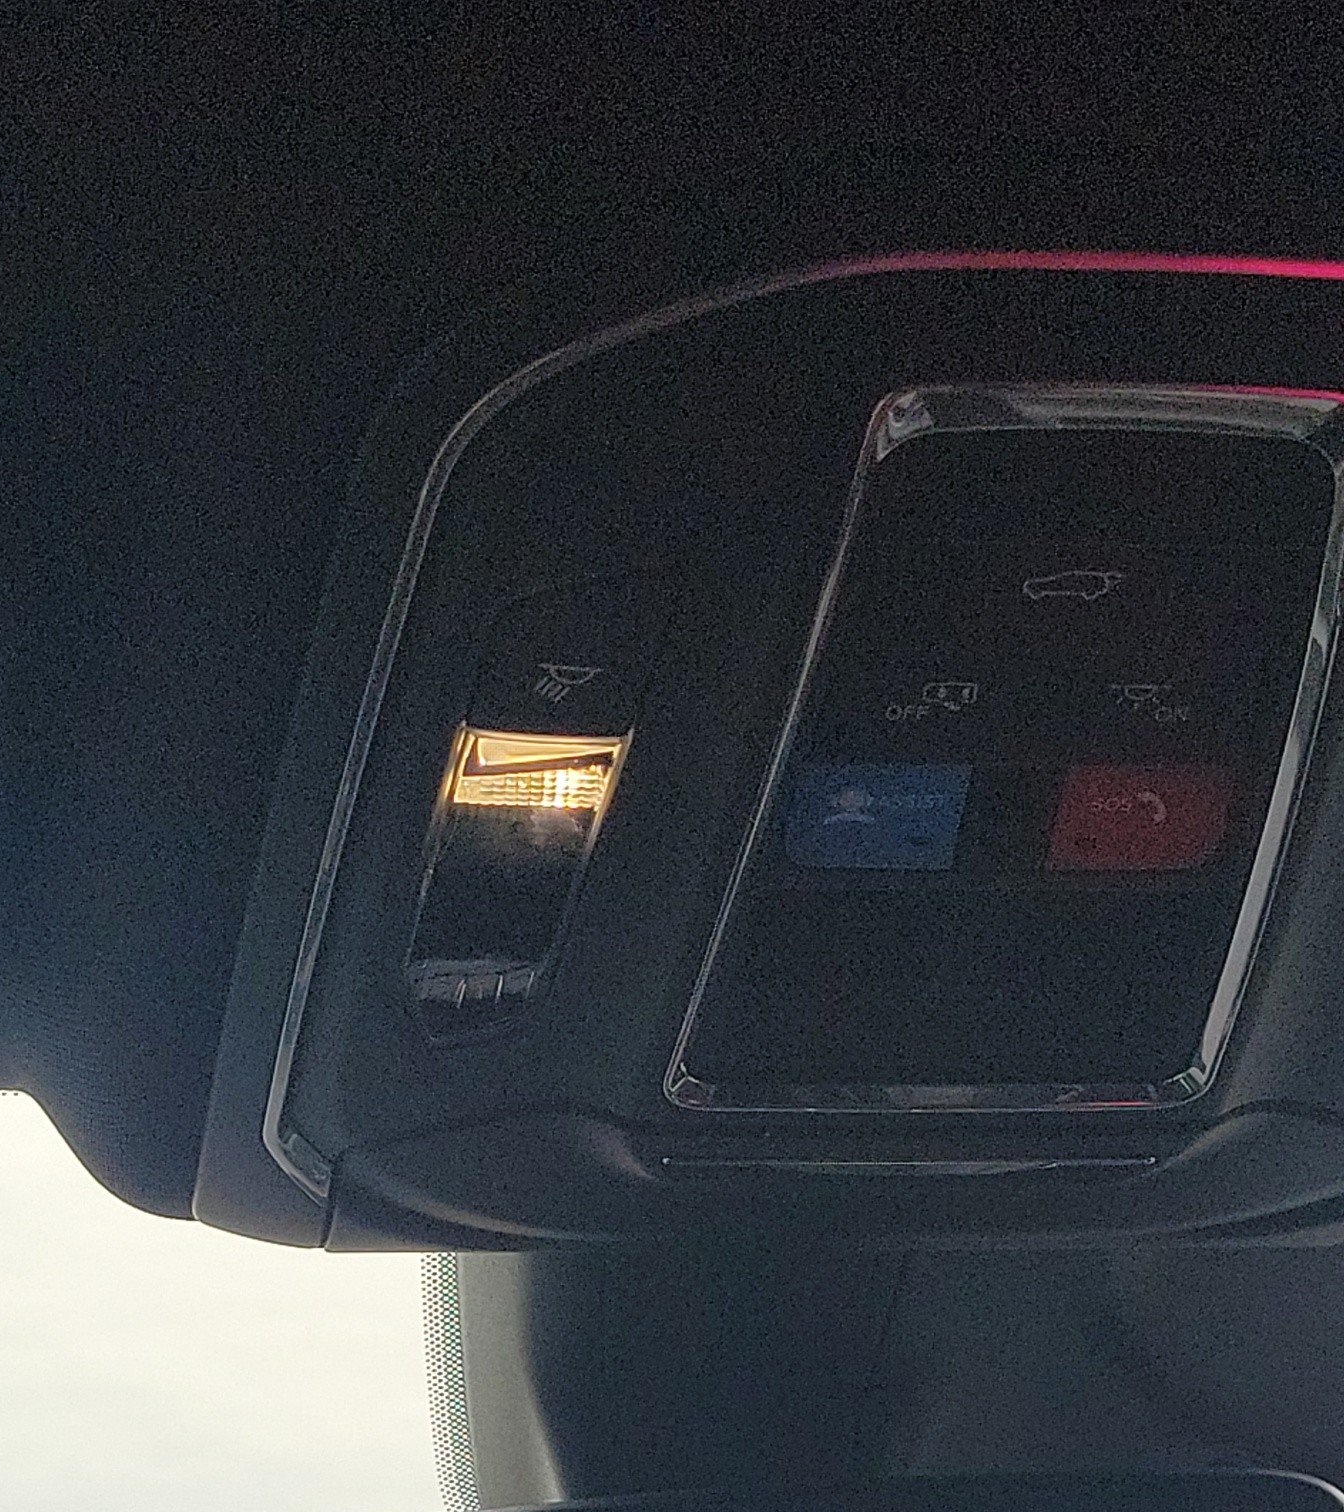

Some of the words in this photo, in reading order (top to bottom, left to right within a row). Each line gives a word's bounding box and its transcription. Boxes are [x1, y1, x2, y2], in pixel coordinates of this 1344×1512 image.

[884, 704, 931, 721] OFF
[1154, 705, 1190, 722] ON
[1088, 797, 1133, 812] SOS
